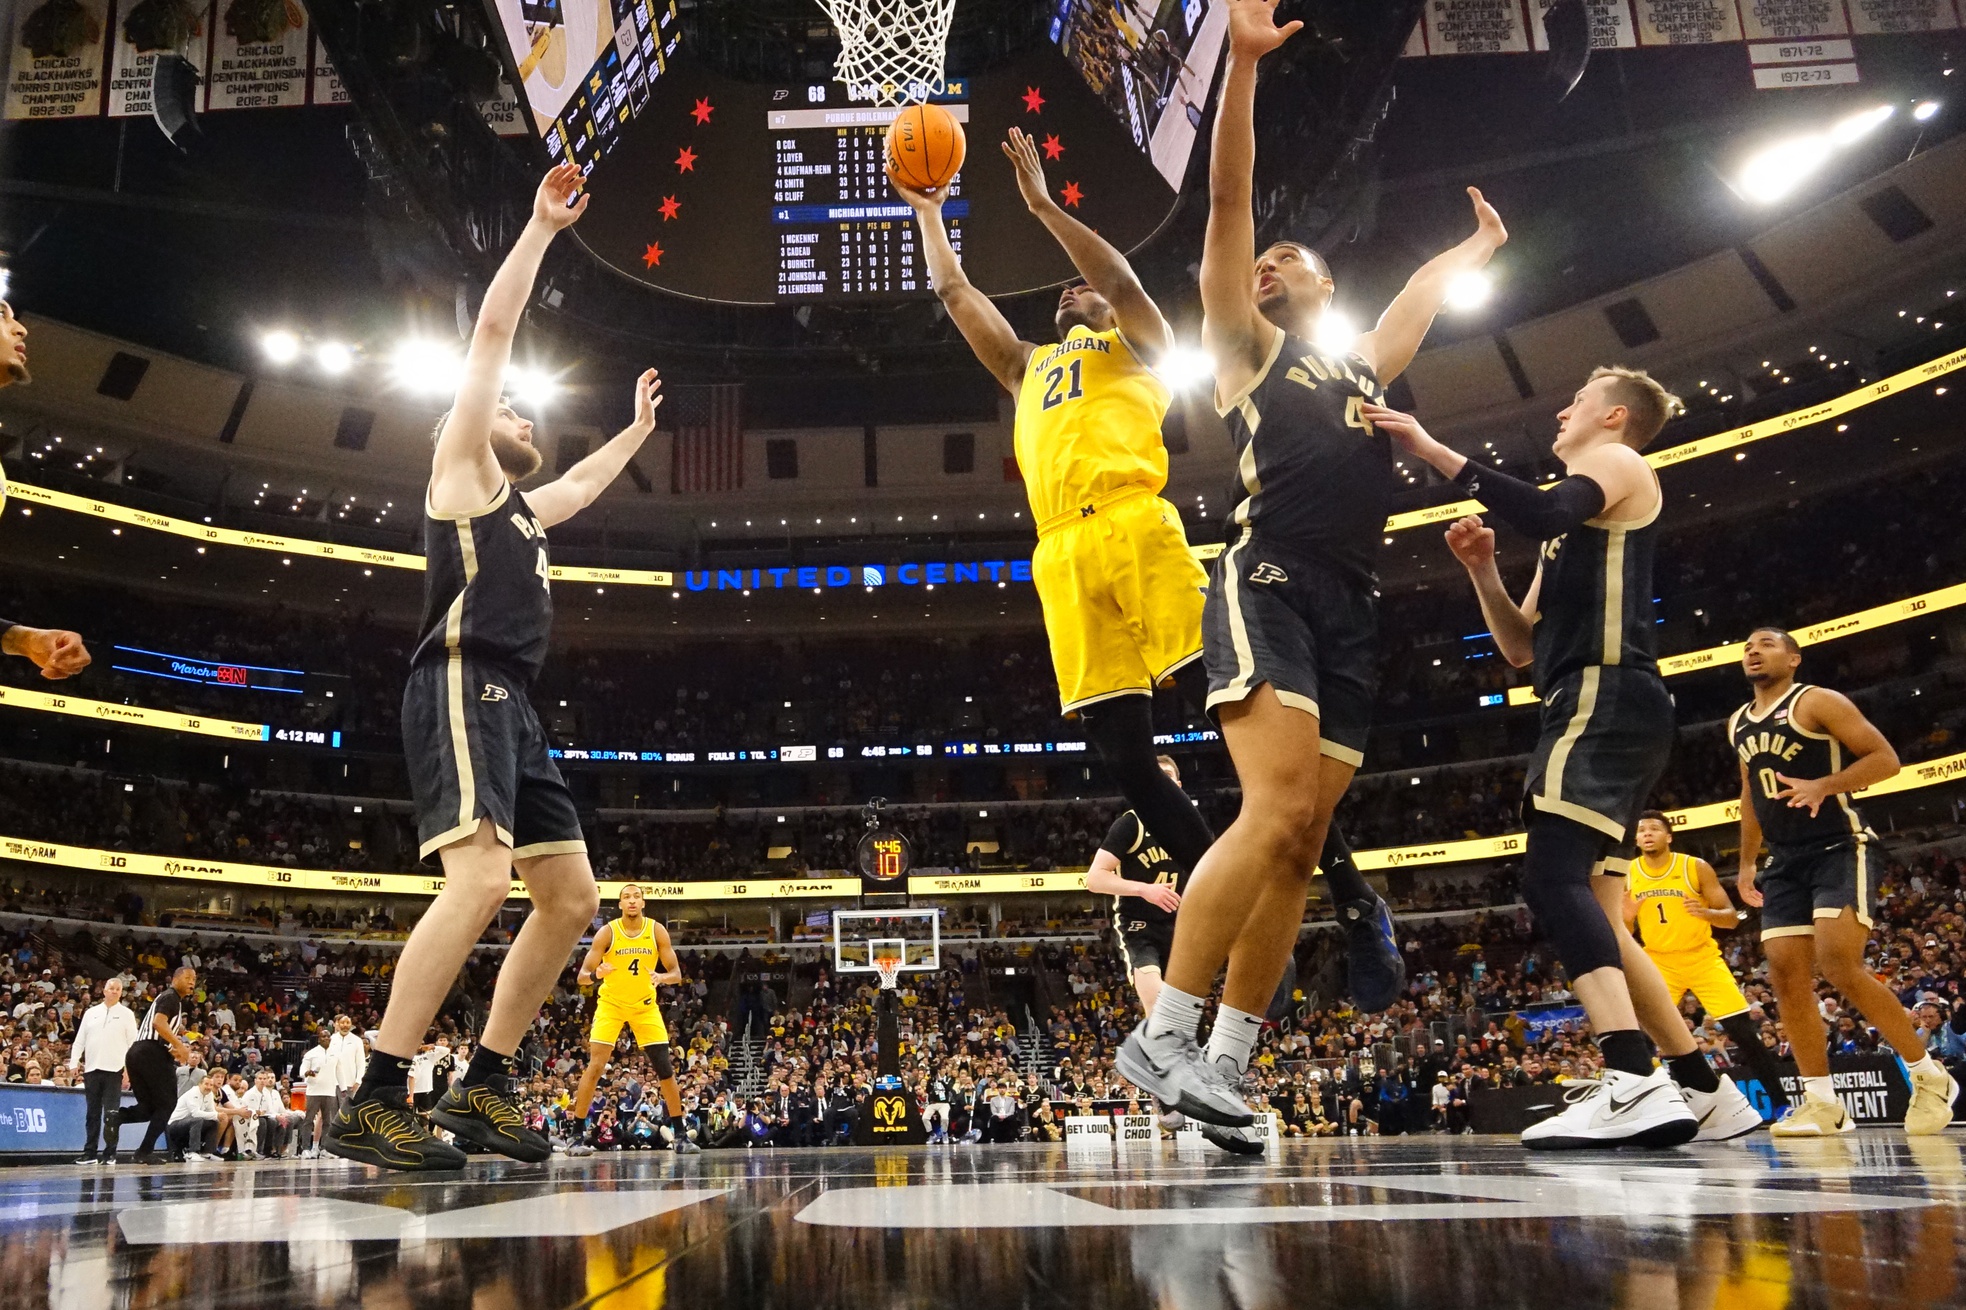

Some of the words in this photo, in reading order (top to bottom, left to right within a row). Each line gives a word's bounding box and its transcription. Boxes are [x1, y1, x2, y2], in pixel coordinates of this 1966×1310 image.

[1654, 2, 1718, 13] CAMPBELL
[1649, 11, 1727, 22] CONFERENCE
[1437, 19, 1515, 32] CONFERENCE
[1656, 21, 1723, 33] CHAMPIONS
[236, 45, 284, 57] CHICAGO
[1779, 46, 1823, 57] 1971-72
[33, 58, 80, 69] CHICAGO
[222, 56, 297, 70] BLACKHAWKS
[18, 68, 93, 81] BLACKHAWKS
[212, 71, 260, 83] CENTRAL
[262, 68, 305, 80] DIVISION
[1781, 70, 1831, 82] 1972-73
[11, 82, 50, 93] NORRIS
[53, 79, 98, 92] DIVISION
[111, 79, 152, 90] CENTRA
[226, 82, 290, 94] CHAMPIONS
[22, 92, 85, 105] CHAMPIONS
[808, 85, 826, 102] 68
[947, 83, 962, 95] M
[236, 95, 278, 107] 2012-13
[29, 105, 76, 117] 1992-93
[825, 112, 855, 124] PURDUE
[782, 139, 796, 150] COX
[838, 138, 847, 148] 22
[783, 152, 803, 162] LOYER
[838, 151, 847, 161] 27
[866, 150, 874, 160] 12
[838, 164, 848, 174] 24
[866, 163, 875, 173] 20
[774, 179, 783, 188] 41
[784, 178, 804, 188] SMITH
[839, 176, 848, 187] 33
[867, 176, 875, 186] 14
[774, 192, 783, 202] 45
[784, 191, 804, 201] CLUFF
[839, 189, 848, 200] 20
[867, 189, 875, 198] 15
[778, 209, 790, 220] #1
[828, 207, 865, 219] MICHIGAN
[865, 206, 913, 217] WOLVERINES
[786, 233, 819, 244] MCKENNEY
[869, 231, 875, 241] 4
[902, 230, 912, 240] 1/6
[950, 229, 961, 239] 2/2
[786, 246, 811, 257] CADEAU
[841, 245, 850, 255] 33
[868, 244, 877, 254] 10
[901, 243, 914, 253] 4/11
[952, 242, 961, 251] 1/2
[780, 259, 786, 269] 4
[787, 258, 815, 269] BURNETT
[841, 257, 850, 268] 23
[869, 256, 877, 267] 10
[901, 255, 912, 266] 4/6
[778, 272, 786, 282] 21
[787, 271, 816, 281] JOHNSON
[842, 270, 850, 280] 21
[901, 268, 913, 278] 2/4
[778, 284, 787, 295] 23
[788, 283, 824, 294] LENDEBORG
[842, 282, 850, 293] 31
[857, 282, 863, 292] 3
[869, 282, 877, 291] 14
[884, 281, 890, 291] 3
[1034, 336, 1111, 378] MICHIGAN
[1042, 358, 1084, 412] 21
[1080, 503, 1096, 518] M
[685, 565, 852, 592] UNITED
[897, 560, 1032, 586] CENTE
[1249, 561, 1289, 585] P
[171, 661, 211, 677] March
[481, 683, 509, 702] P
[275, 729, 304, 743] 4:12
[305, 731, 325, 744] PM
[708, 752, 736, 761] FOULS
[750, 750, 767, 760] TOL
[770, 750, 777, 759] 3
[984, 744, 1001, 754] TOL
[1003, 743, 1011, 753] 2
[1014, 743, 1043, 753] FOULS
[1056, 741, 1086, 752] BONUS
[1738, 731, 1804, 764] URDUE
[590, 751, 617, 760] 30.8%
[618, 751, 638, 761] FT%
[666, 752, 695, 762] BONUS
[1758, 767, 1778, 800] 0
[38, 846, 57, 859] RAM
[874, 840, 901, 854] 4:46
[1405, 850, 1446, 860] RAM
[182, 864, 224, 875] RAM
[877, 853, 901, 876] 10
[363, 877, 381, 887] RAM
[964, 879, 981, 889] RAM
[667, 886, 684, 895] RAM
[1656, 902, 1668, 924] 1
[1128, 920, 1147, 932] P
[615, 947, 653, 956] MICHIGAN
[627, 958, 640, 976] 4
[436, 1067, 443, 1076] 5
[1832, 1070, 1887, 1090] ASKETBALL
[1123, 1116, 1151, 1128] CHOO
[873, 1125, 908, 1133] RAM
[1067, 1124, 1083, 1135] GET
[1086, 1124, 1110, 1134] LOUD
[1124, 1128, 1152, 1140] CHOO
